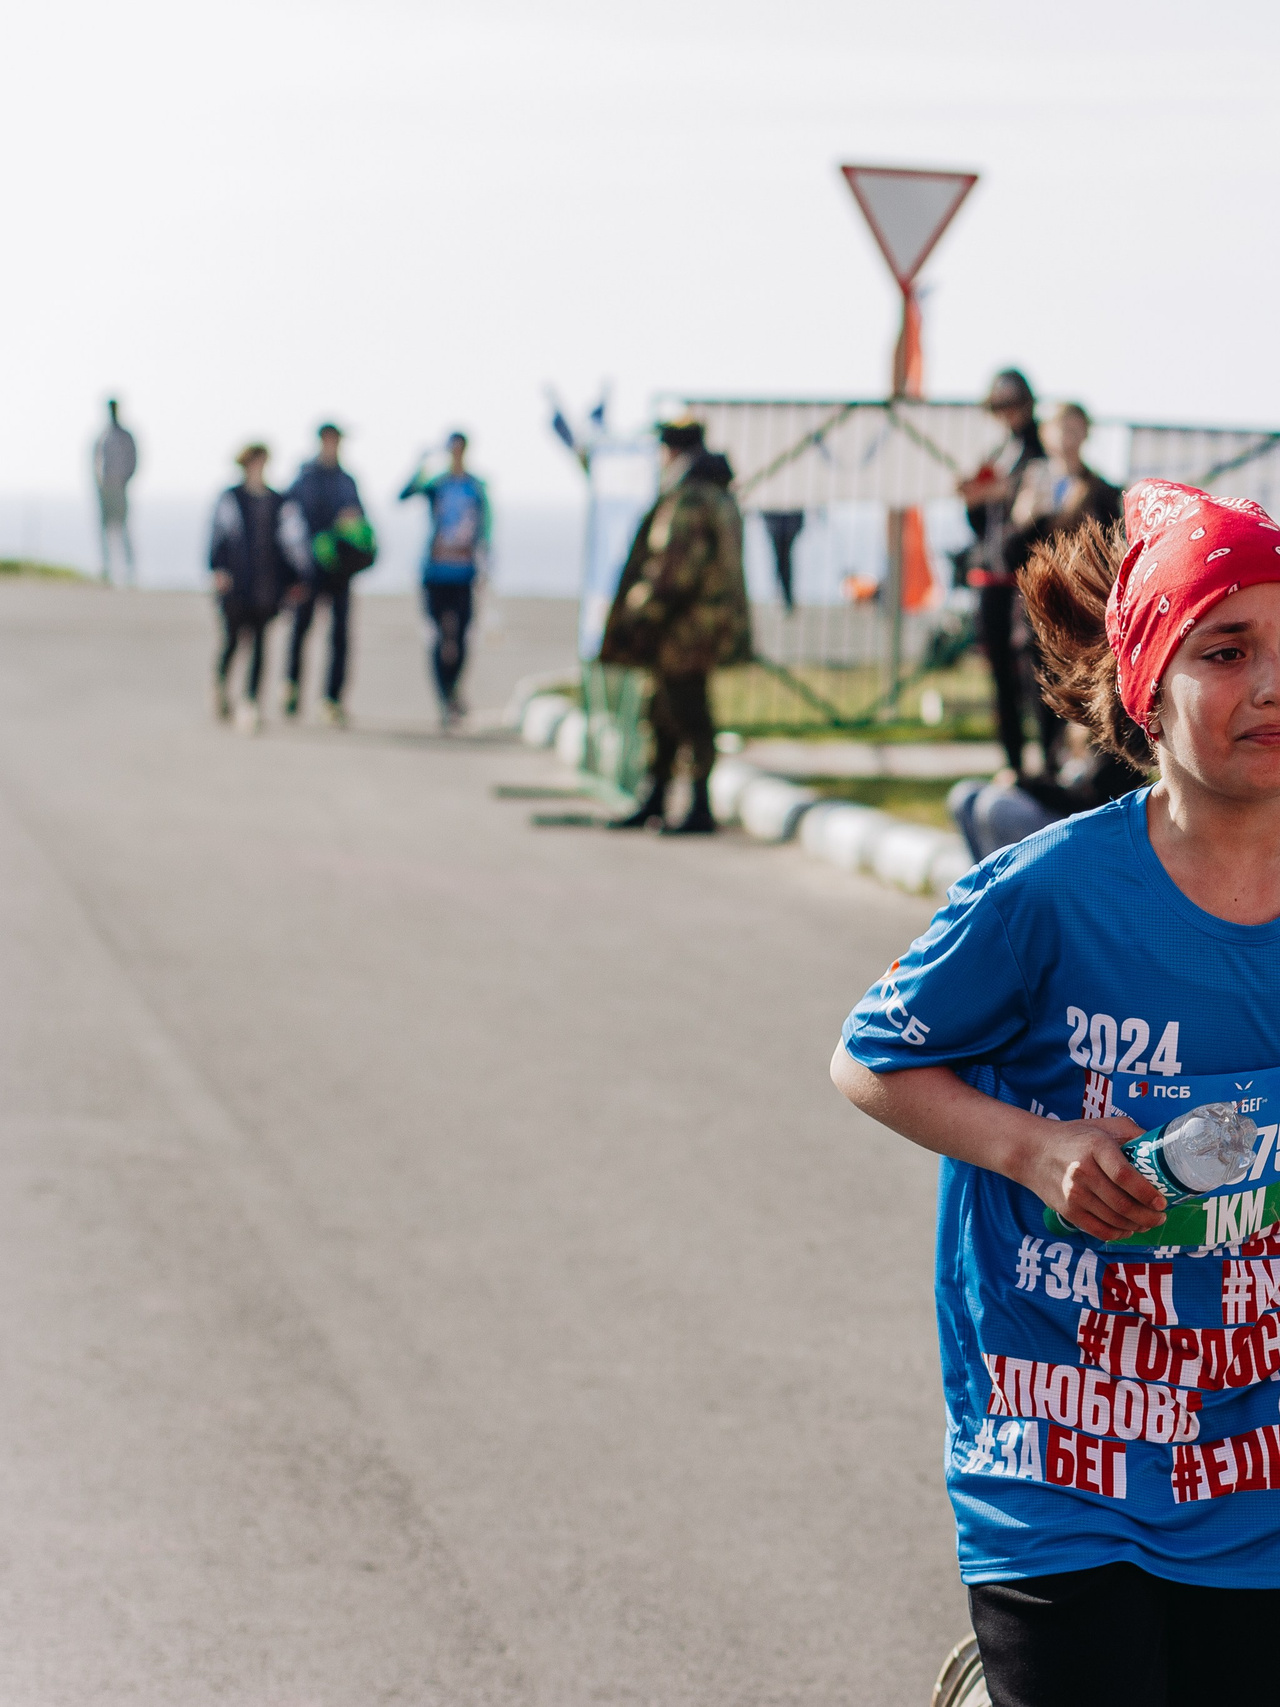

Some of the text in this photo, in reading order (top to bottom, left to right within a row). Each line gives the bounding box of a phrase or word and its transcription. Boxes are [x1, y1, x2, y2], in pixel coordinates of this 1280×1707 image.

[880, 980, 931, 1046] ПСБ
[1066, 1005, 1182, 1077] 2024
[1153, 1085, 1191, 1100] ПСБ
[1015, 1234, 1179, 1326] #ЗАБЕГ
[961, 1417, 1127, 1500] #ЗАБЕГ
